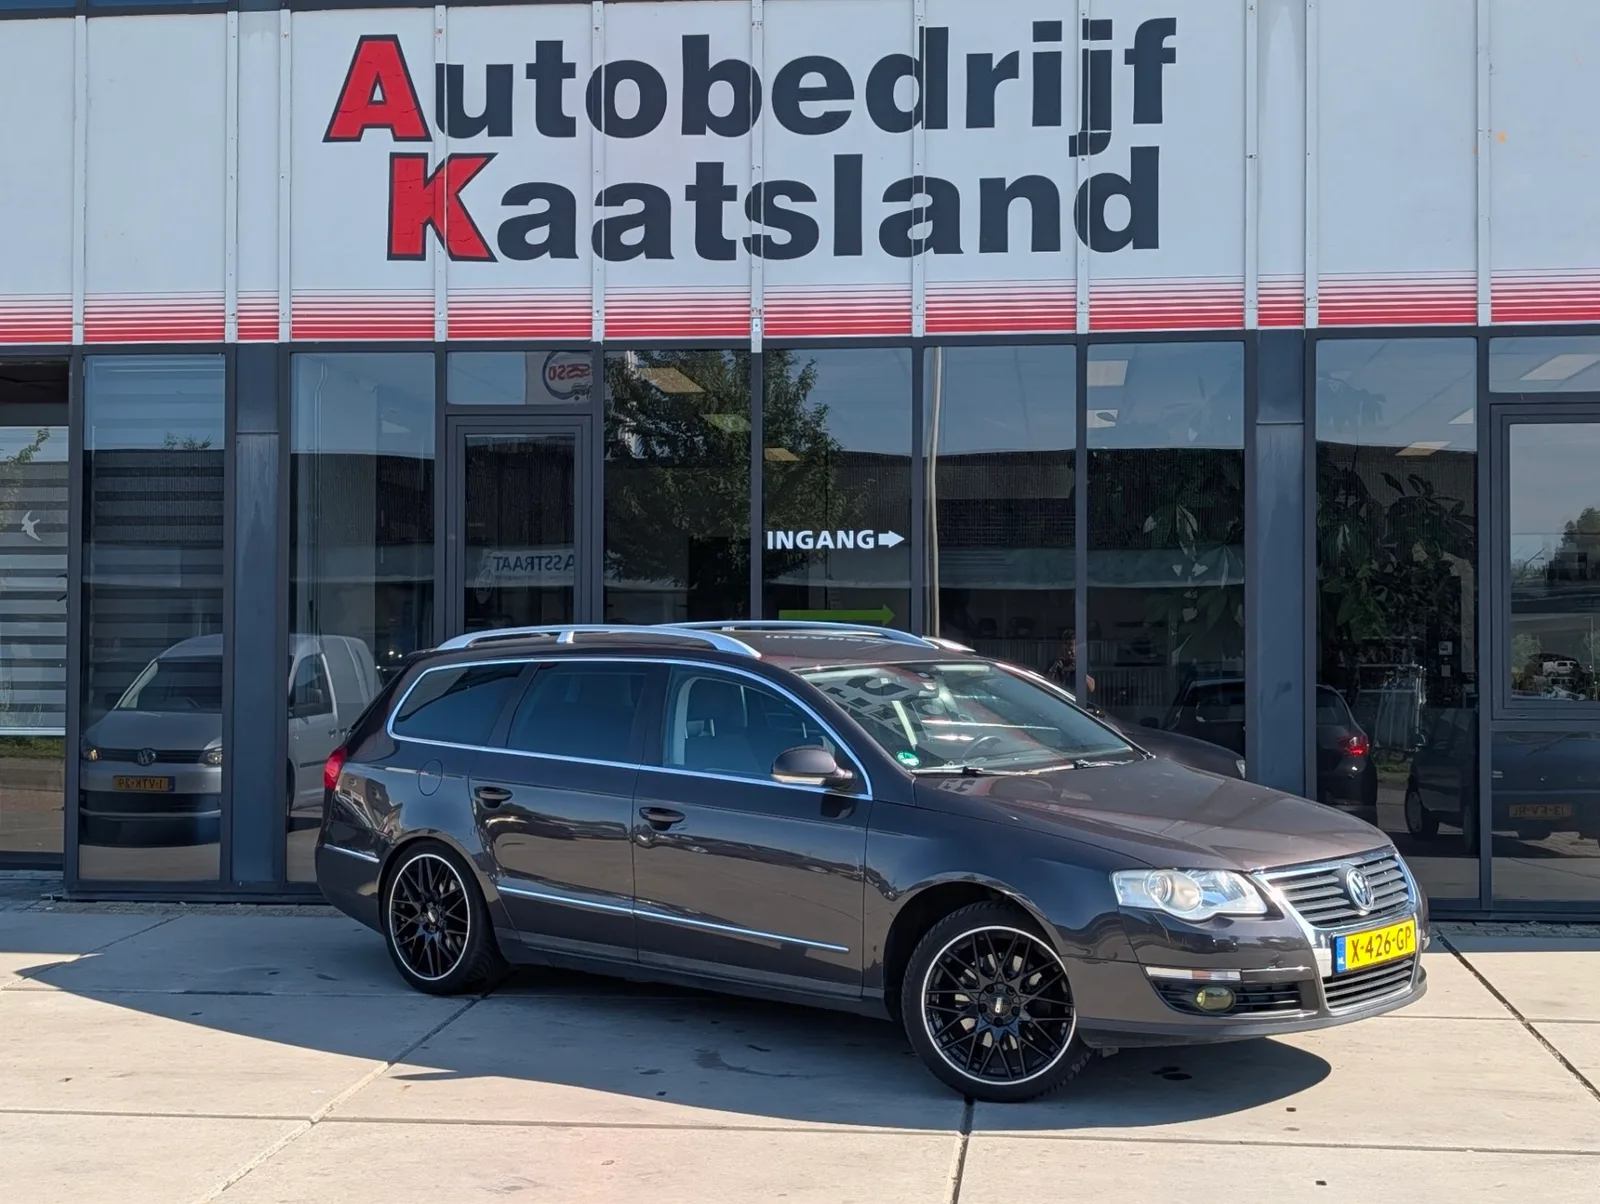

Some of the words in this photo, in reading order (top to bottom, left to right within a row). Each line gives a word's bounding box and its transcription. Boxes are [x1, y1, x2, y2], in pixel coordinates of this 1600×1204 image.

[323, 17, 1177, 157] Autobedrijf
[386, 145, 1160, 262] Kaatsland
[767, 530, 874, 549] INGANG
[1351, 926, 1411, 963] X-426-GP
